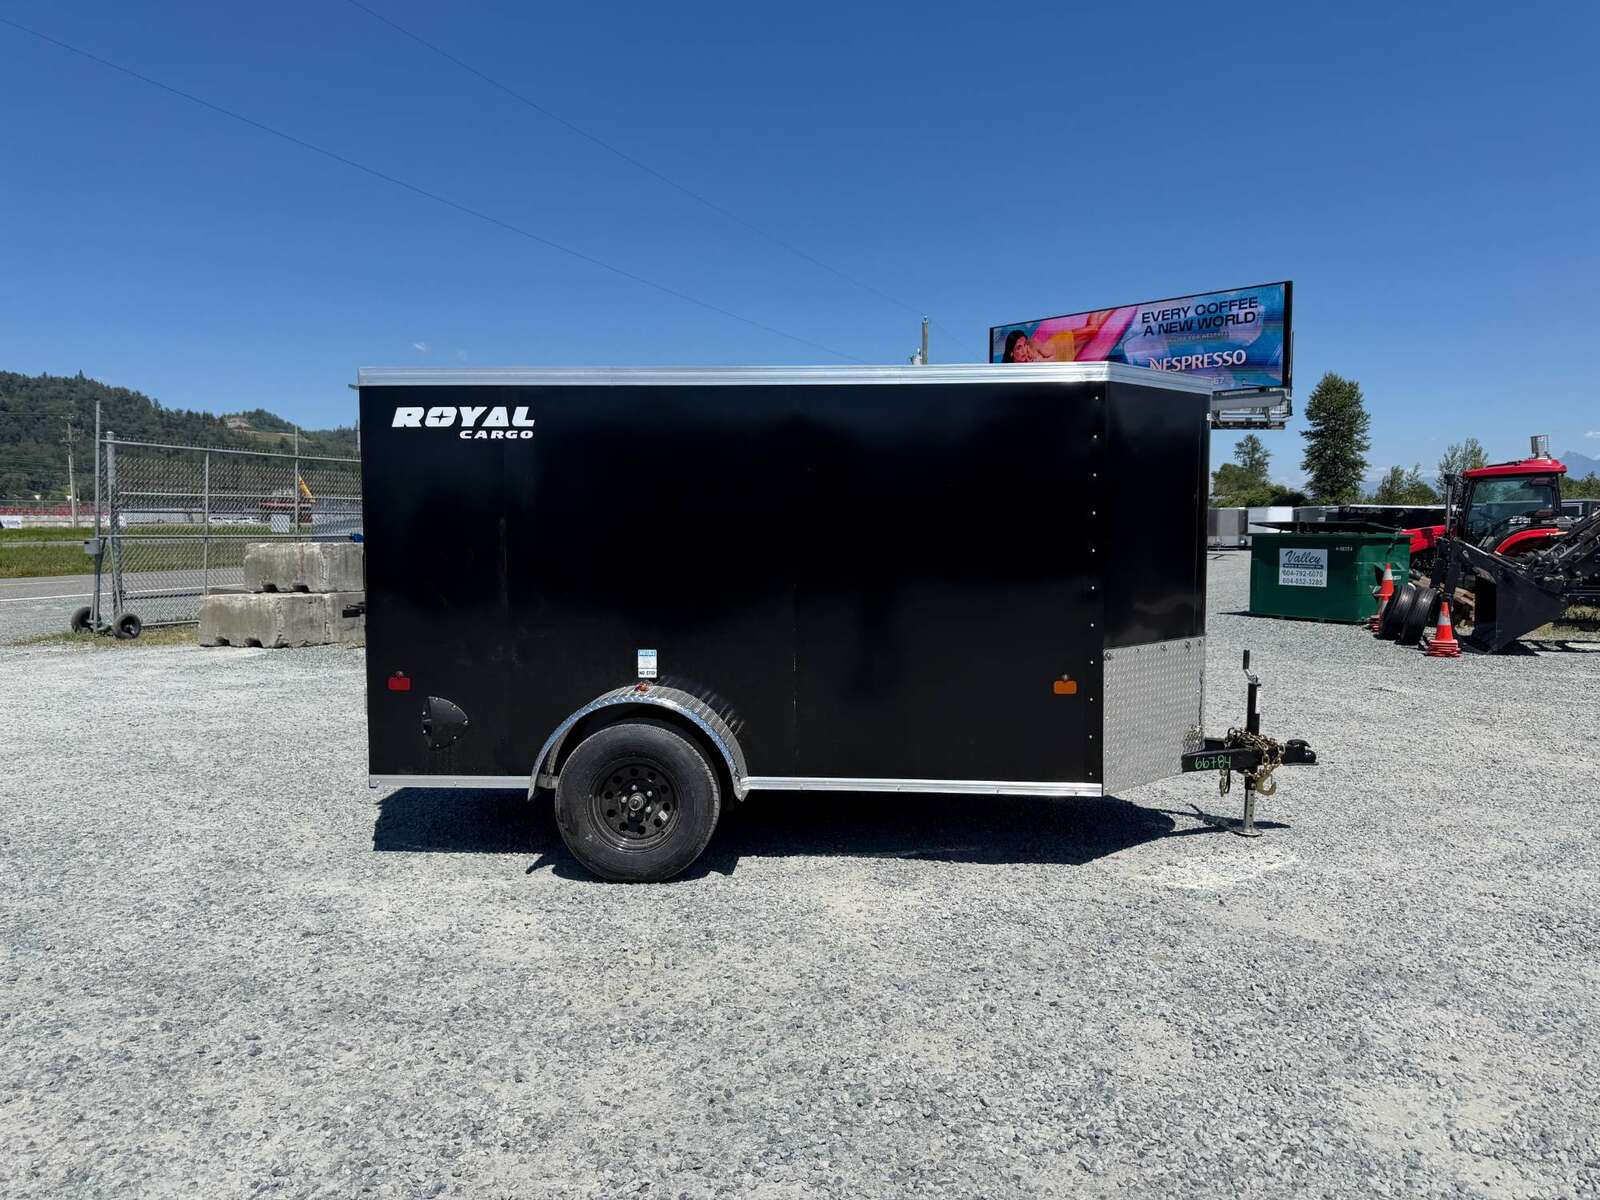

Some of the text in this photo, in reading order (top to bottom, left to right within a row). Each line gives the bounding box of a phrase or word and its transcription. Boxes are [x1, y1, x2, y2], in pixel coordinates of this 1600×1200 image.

[1142, 297, 1258, 323] EVERY COFFEE
[1143, 326, 1154, 336] A
[1158, 319, 1193, 335] NEW
[1197, 311, 1256, 330] WORLD
[1147, 349, 1247, 372] NESPRESSO
[391, 406, 535, 428] ROYAL
[459, 430, 534, 439] CARGO
[1285, 550, 1321, 564] Valley
[1195, 755, 1232, 769] 66784
